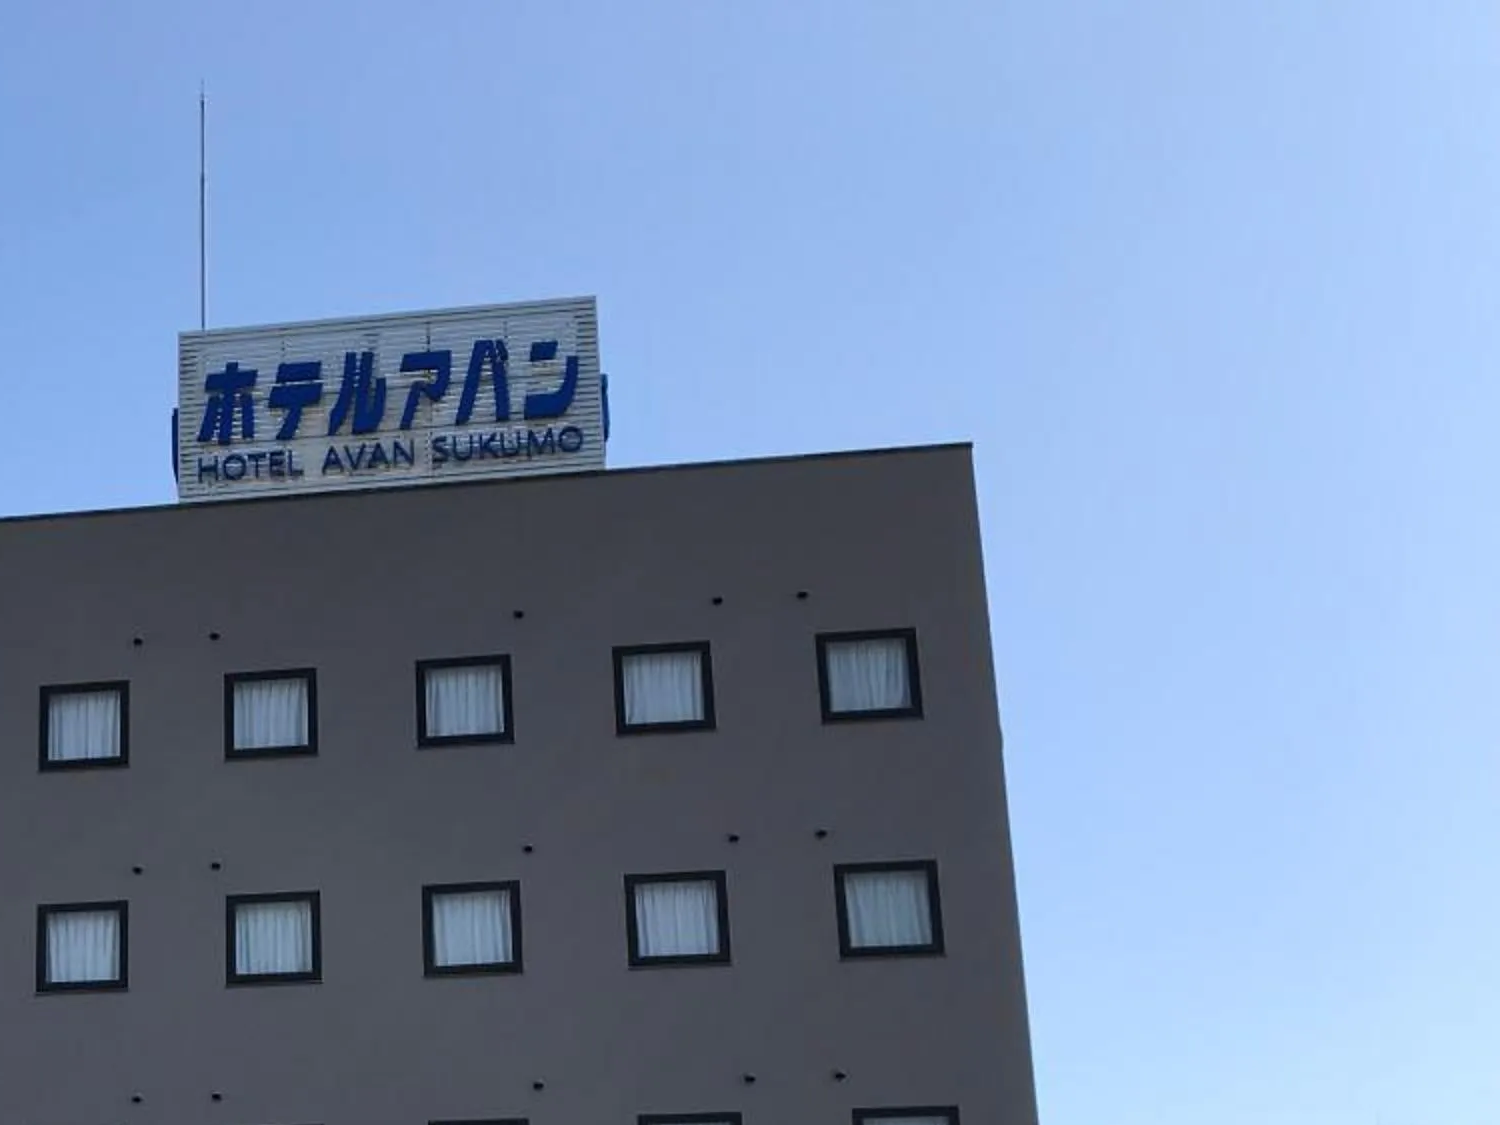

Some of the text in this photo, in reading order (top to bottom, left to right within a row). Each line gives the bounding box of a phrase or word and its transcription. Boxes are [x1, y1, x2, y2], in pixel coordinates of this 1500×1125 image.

[198, 340, 578, 445] ホテルアバン
[198, 426, 583, 483] HOTEL AVAN SUKUMO
